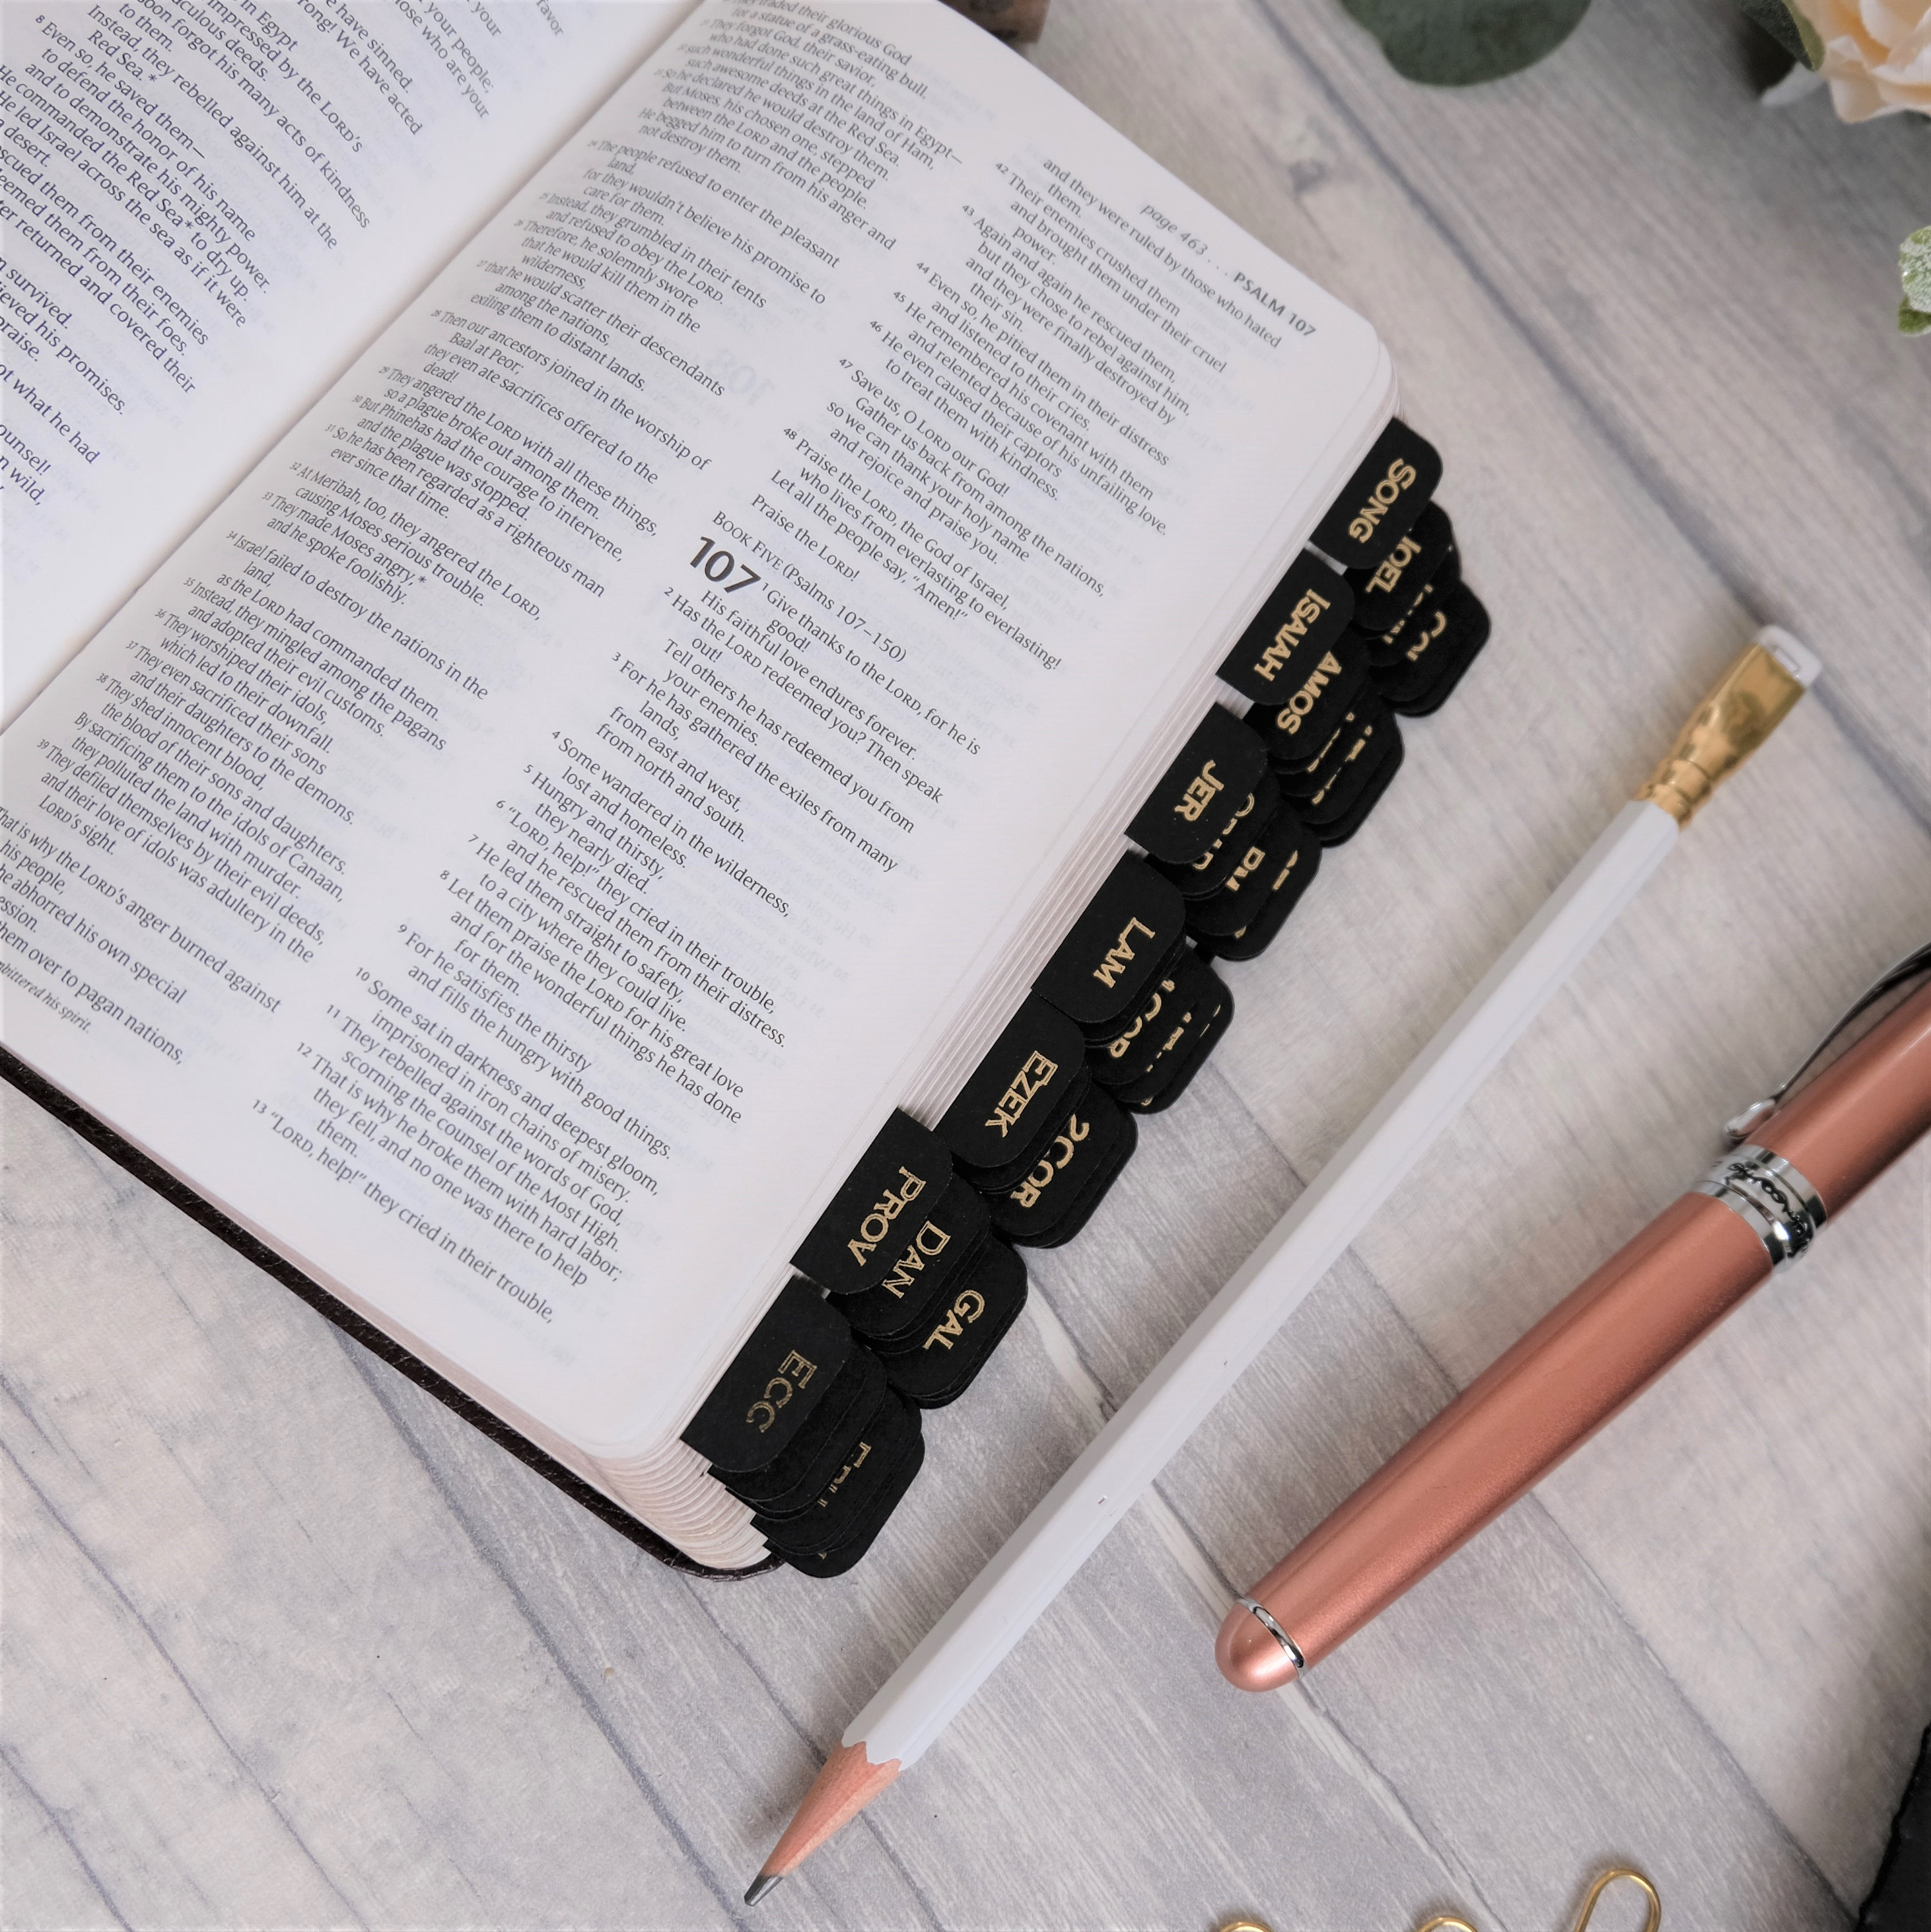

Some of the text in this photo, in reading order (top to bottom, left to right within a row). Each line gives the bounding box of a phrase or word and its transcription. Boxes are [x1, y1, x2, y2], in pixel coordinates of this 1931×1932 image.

[41, 21, 76, 52] Even
[74, 48, 93, 68] so,
[95, 61, 117, 82] he
[114, 79, 159, 117] saved
[256, 10, 298, 52] Egypt
[423, 1, 494, 93] your people;
[87, 4, 337, 250] Instead, they rebelled against him at the
[336, 28, 423, 135] We have acted
[733, 35, 759, 49] had
[757, 42, 790, 61] done
[789, 55, 821, 75] such
[818, 71, 857, 95] great
[856, 88, 899, 120] things
[898, 114, 914, 131] in
[24, 64, 270, 294] and to demonstrate his mighty power.
[545, 211, 571, 223] and
[568, 216, 618, 241] refused
[615, 234, 630, 247] to
[630, 243, 664, 267] obey
[663, 259, 688, 279] the
[1043, 159, 1282, 348] and they were ruled by those who hated
[1140, 205, 1317, 336] page 463 PSALM 107
[5, 269, 73, 329] survived.
[13, 378, 100, 464] what he had
[387, 368, 415, 387] They
[412, 379, 466, 408] angered
[462, 401, 486, 421] the
[522, 436, 554, 463] with
[553, 458, 576, 475] all
[573, 469, 612, 501] these
[612, 495, 657, 536] things,
[851, 370, 883, 399] Save
[883, 395, 901, 417] us,
[903, 410, 918, 424] O
[952, 450, 977, 471] our
[977, 468, 1010, 497] God!
[1348, 458, 1417, 544] SONG
[782, 564, 835, 610] (Psalms
[690, 536, 762, 594] 107
[767, 590, 798, 619] Give
[798, 614, 845, 654] thanks
[845, 649, 861, 666] to
[861, 661, 885, 685] the
[923, 708, 948, 730] for
[947, 723, 966, 745] he
[966, 737, 981, 755] is
[700, 589, 917, 761] His faithful love endures forever.
[766, 619, 811, 653] good!
[1253, 589, 1332, 682] ISAIAH
[134, 645, 164, 671] They
[160, 663, 191, 687] even
[189, 681, 259, 728] sacrificed
[256, 721, 294, 751] their
[290, 748, 327, 775] sons
[1276, 651, 1342, 735] AMOS
[71, 736, 301, 899] they polluted the land with murder.
[558, 737, 601, 775] Some
[601, 770, 673, 828] wandered
[670, 820, 688, 840] in
[688, 834, 713, 858] the
[714, 853, 789, 918] wilderness,
[1173, 760, 1225, 822] JER
[447, 878, 475, 904] Let
[474, 898, 513, 933] them
[511, 928, 560, 967] praise
[560, 960, 586, 985] the
[624, 1007, 650, 1030] for
[648, 1022, 674, 1048] his
[670, 1043, 713, 1076] great
[711, 1067, 744, 1098] love
[1093, 916, 1156, 989] LAM
[984, 1050, 1059, 1138] EZEK
[1010, 1114, 1091, 1209] 2COR
[364, 1182, 400, 1214] they
[399, 1208, 442, 1242] cried
[438, 1233, 457, 1254] in
[457, 1247, 497, 1279] their
[496, 1273, 552, 1324] trouble,
[847, 1166, 927, 1267] PROV
[881, 1220, 951, 1299] DAN
[923, 1289, 986, 1350] GAL
[746, 1349, 817, 1433] ECC
